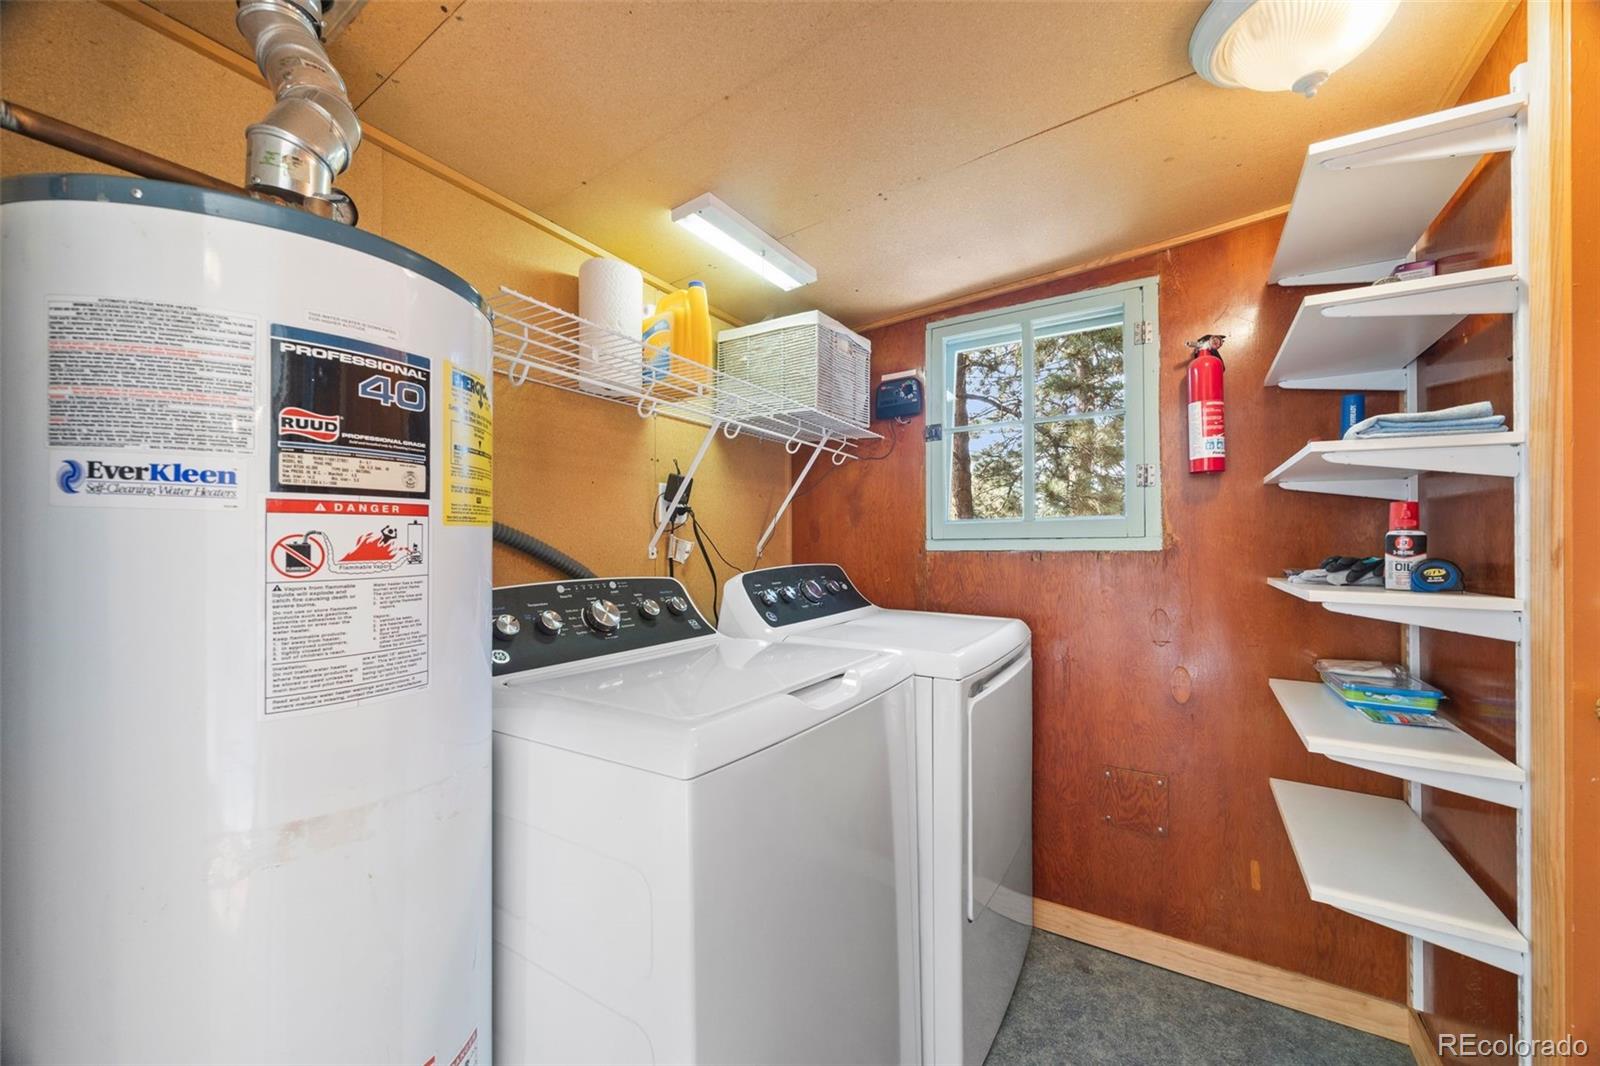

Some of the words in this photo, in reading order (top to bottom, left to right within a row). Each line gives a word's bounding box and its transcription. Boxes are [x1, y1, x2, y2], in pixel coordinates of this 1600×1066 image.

[280, 342, 426, 380] PROFESSIONAL
[358, 374, 426, 412] 40
[281, 417, 338, 432] RUUD
[341, 432, 402, 444] PROFESSIONAL
[86, 460, 236, 485] EverKleen
[86, 482, 156, 496] Self-Cleaning
[159, 486, 192, 496] Water
[194, 488, 238, 498] Heaters
[334, 503, 400, 514] DANGER
[1395, 562, 1412, 572] OIL
